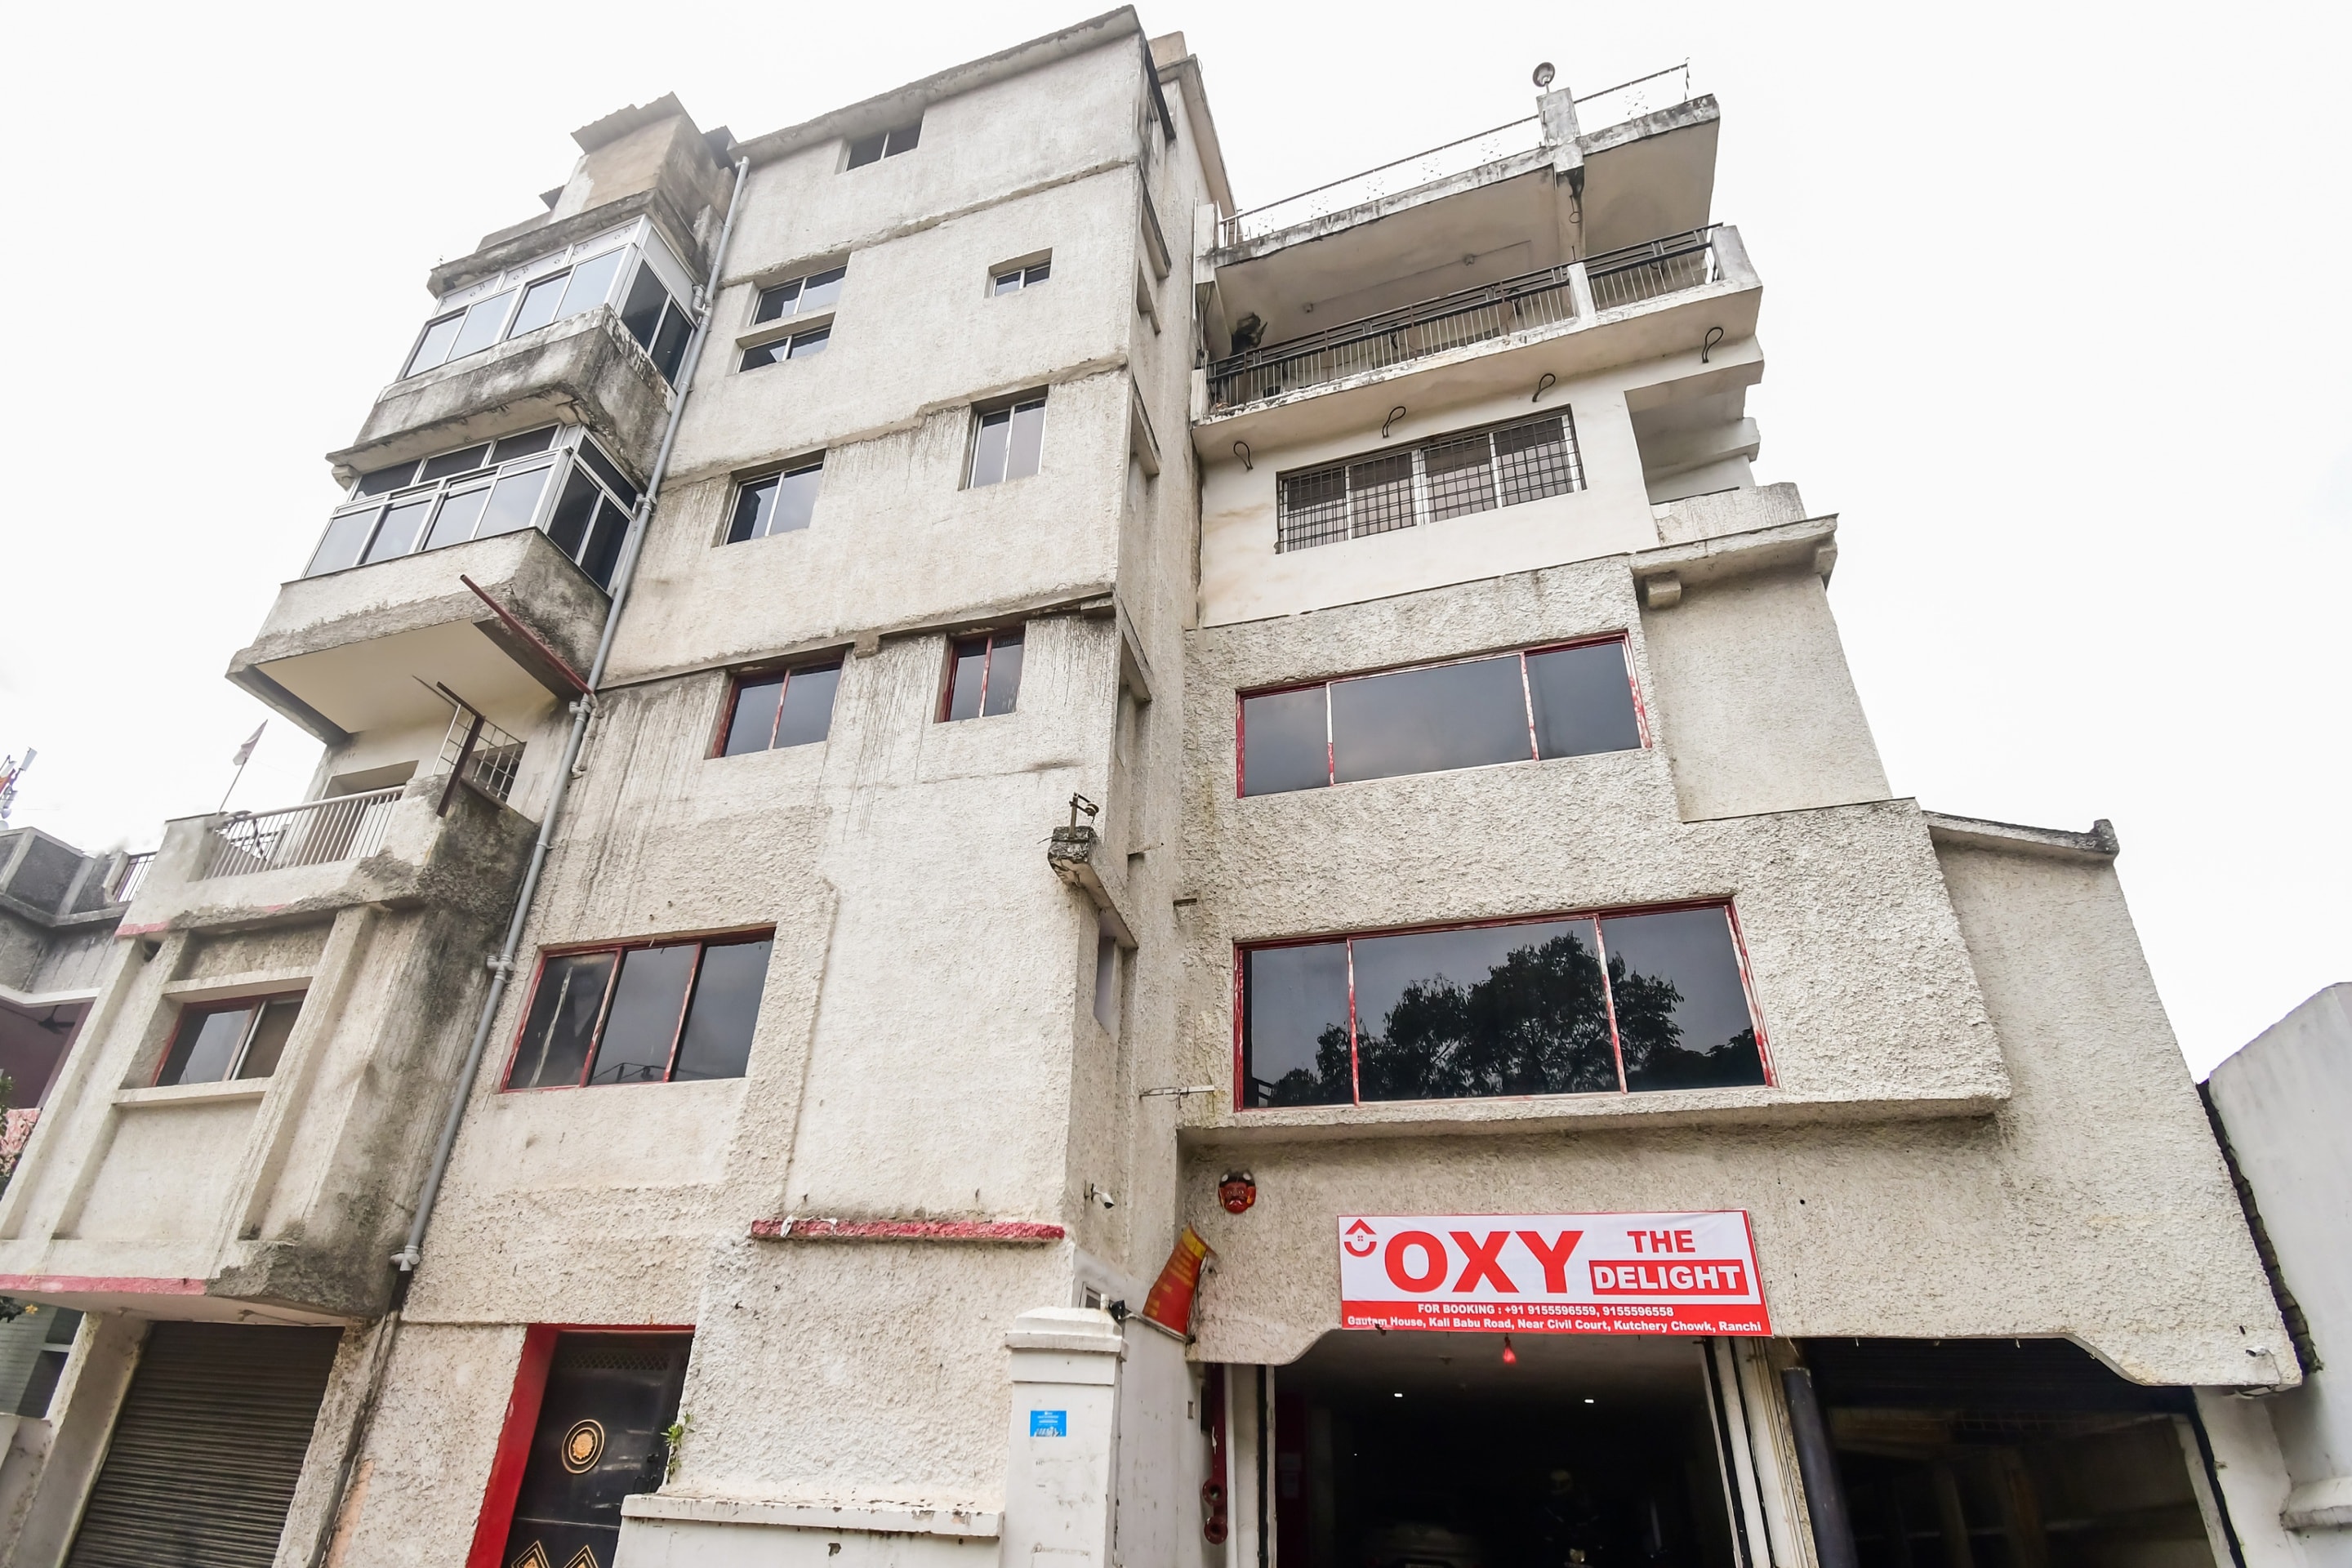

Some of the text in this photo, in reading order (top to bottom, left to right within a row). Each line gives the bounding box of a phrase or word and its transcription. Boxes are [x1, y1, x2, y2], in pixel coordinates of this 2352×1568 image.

[1627, 1230, 1696, 1254] THE
[1384, 1230, 1584, 1294] OXY
[1593, 1265, 1740, 1290] DELIGHT
[1418, 1303, 1440, 1314] FOR
[1443, 1304, 1495, 1315] BOOKING
[1504, 1305, 1525, 1315] +91
[1528, 1305, 1600, 1317] 9155596559,
[1603, 1306, 1674, 1316] 9155596558
[1390, 1316, 1426, 1328] House,
[1429, 1317, 1450, 1327] Kali
[1453, 1318, 1481, 1328] Babu
[1484, 1319, 1515, 1330] Road,
[1517, 1319, 1544, 1329] Near
[1548, 1320, 1572, 1330] Civil
[1575, 1320, 1611, 1331] Court,
[1614, 1321, 1668, 1333] Kutchery
[1671, 1321, 1716, 1333] Chowk,
[1719, 1321, 1762, 1332] Ranchi
